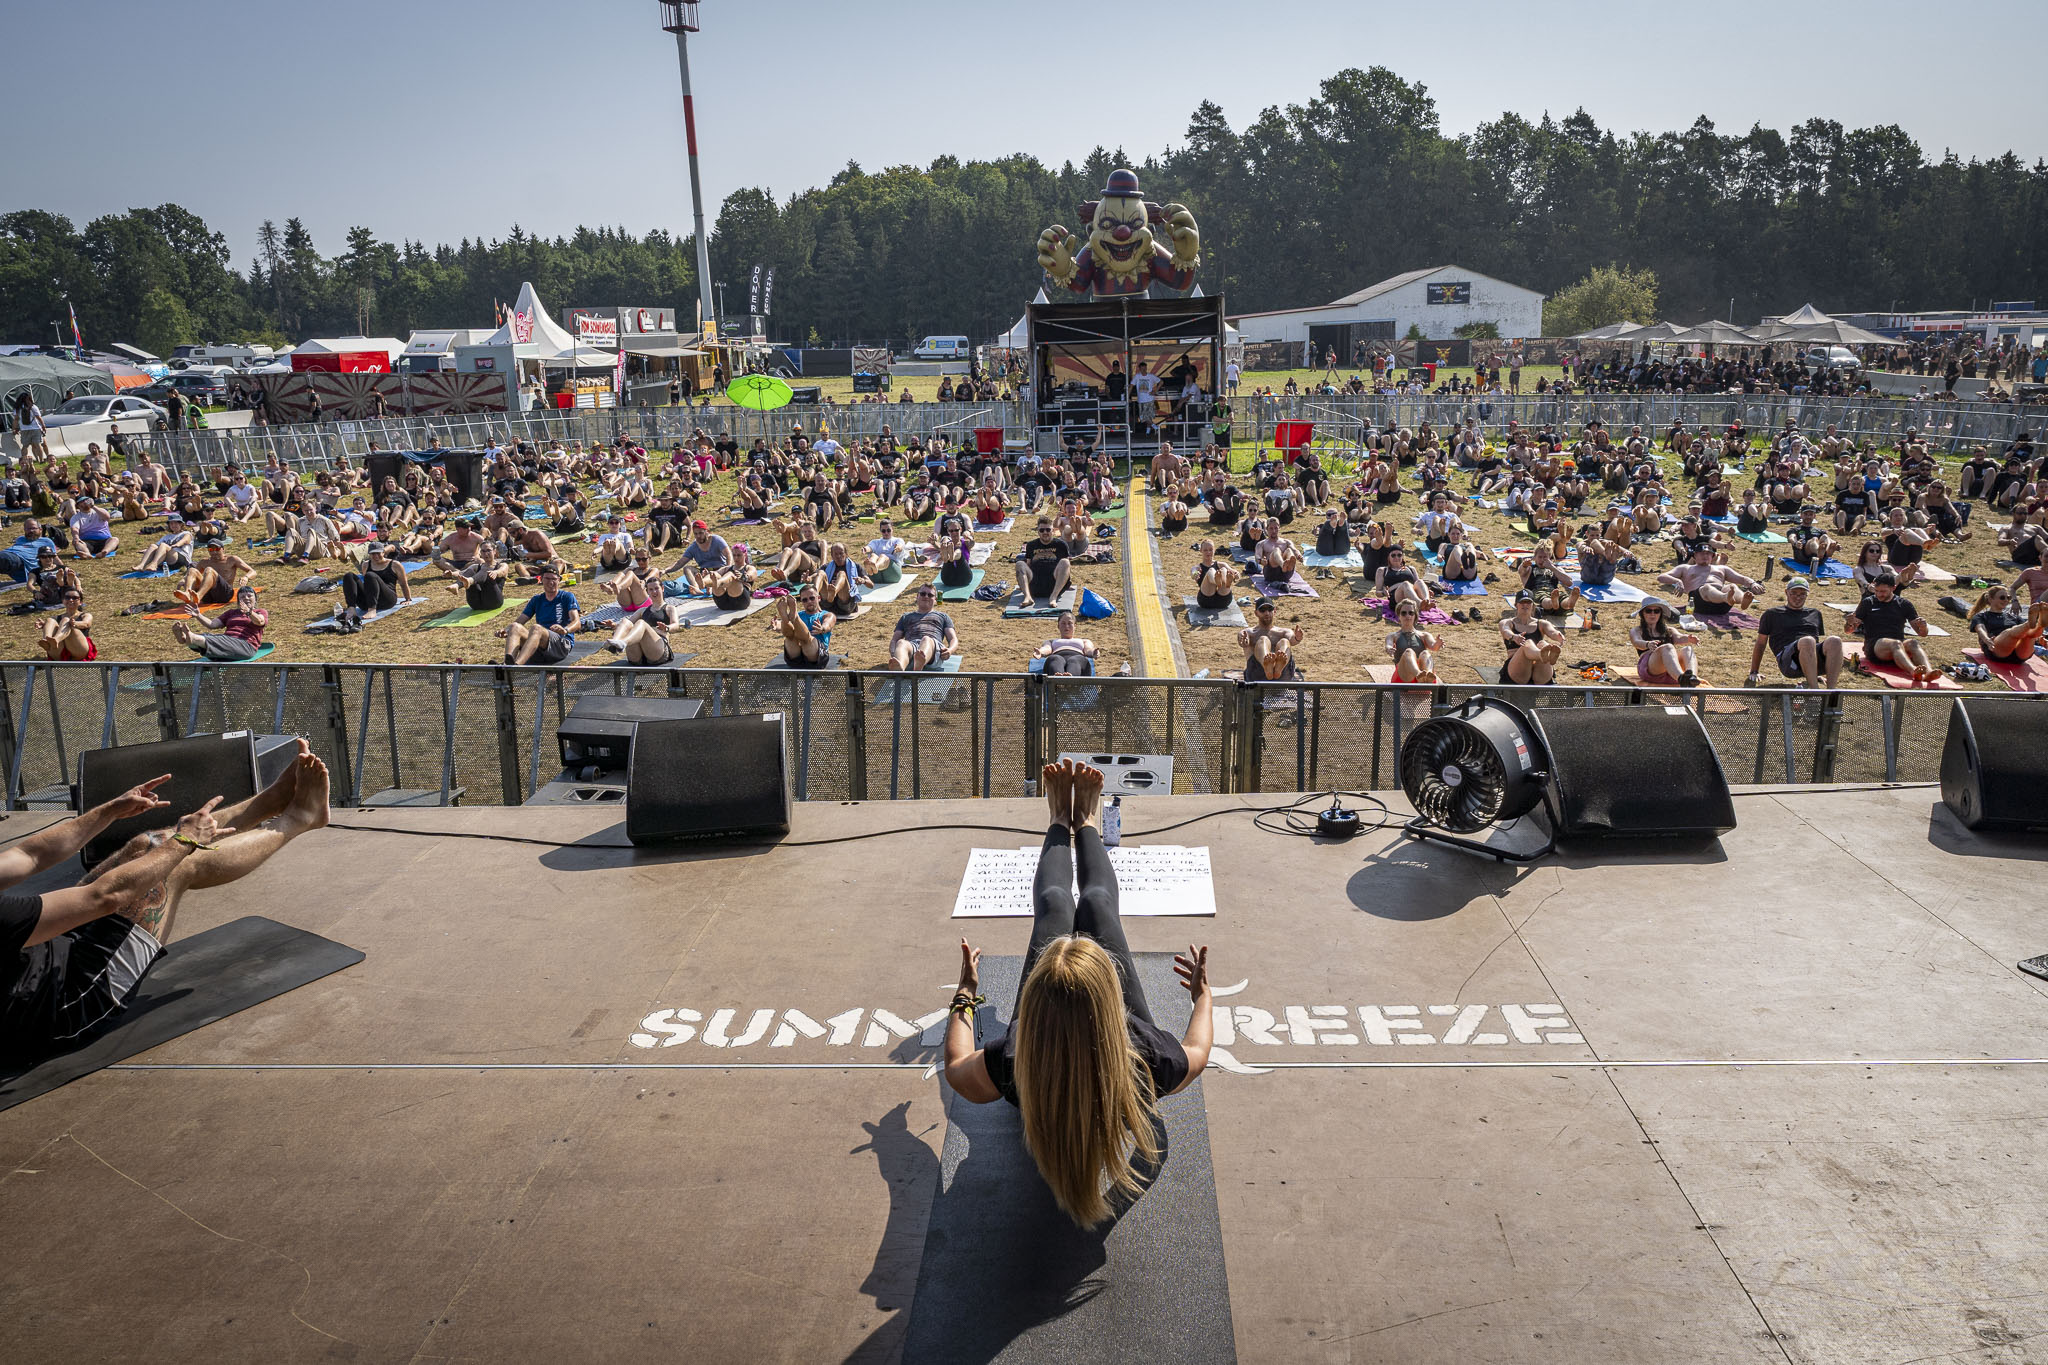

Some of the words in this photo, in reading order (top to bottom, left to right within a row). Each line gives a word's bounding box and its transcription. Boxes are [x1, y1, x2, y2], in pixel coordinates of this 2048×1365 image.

[750, 265, 761, 313] DÖNER
[629, 1007, 950, 1049] SUMM
[1211, 1003, 1587, 1046] REEZE
